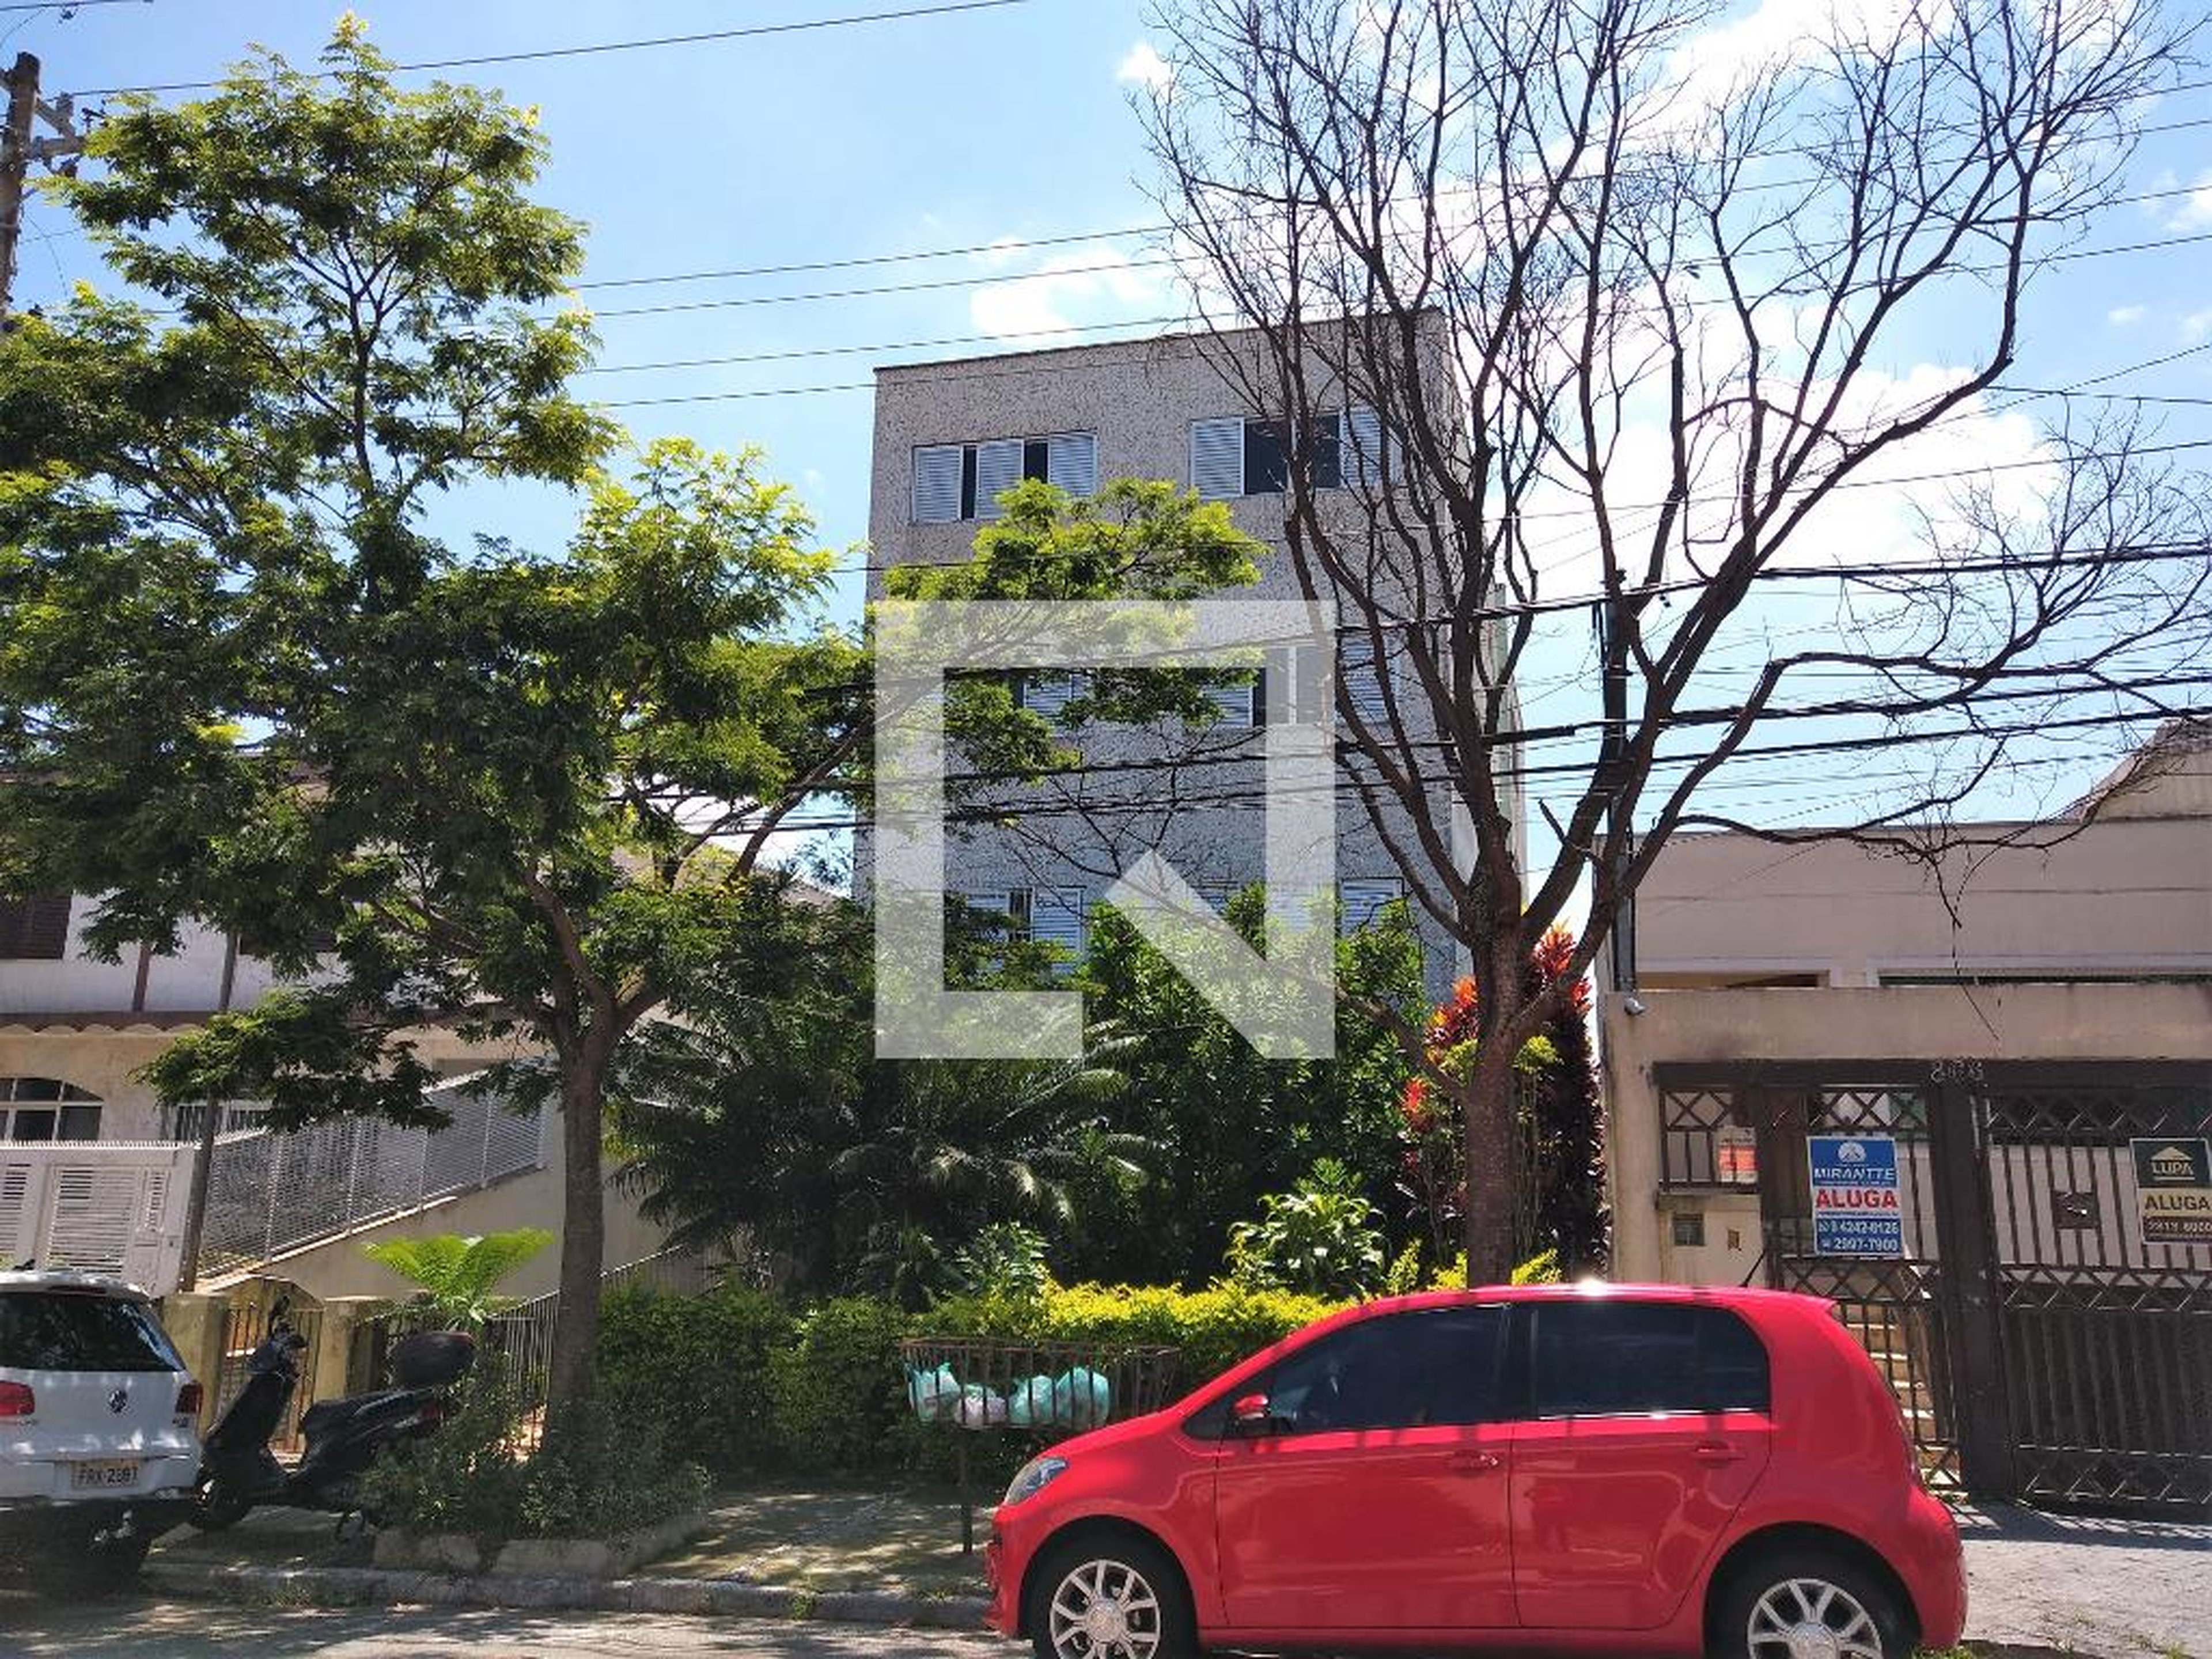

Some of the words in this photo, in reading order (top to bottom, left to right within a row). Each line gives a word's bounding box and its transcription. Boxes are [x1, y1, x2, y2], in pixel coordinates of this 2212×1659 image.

[2152, 1162, 2194, 1176] LUPA
[1816, 1189, 1899, 1208] ALUGA
[2145, 1195, 2210, 1210] ALUGA
